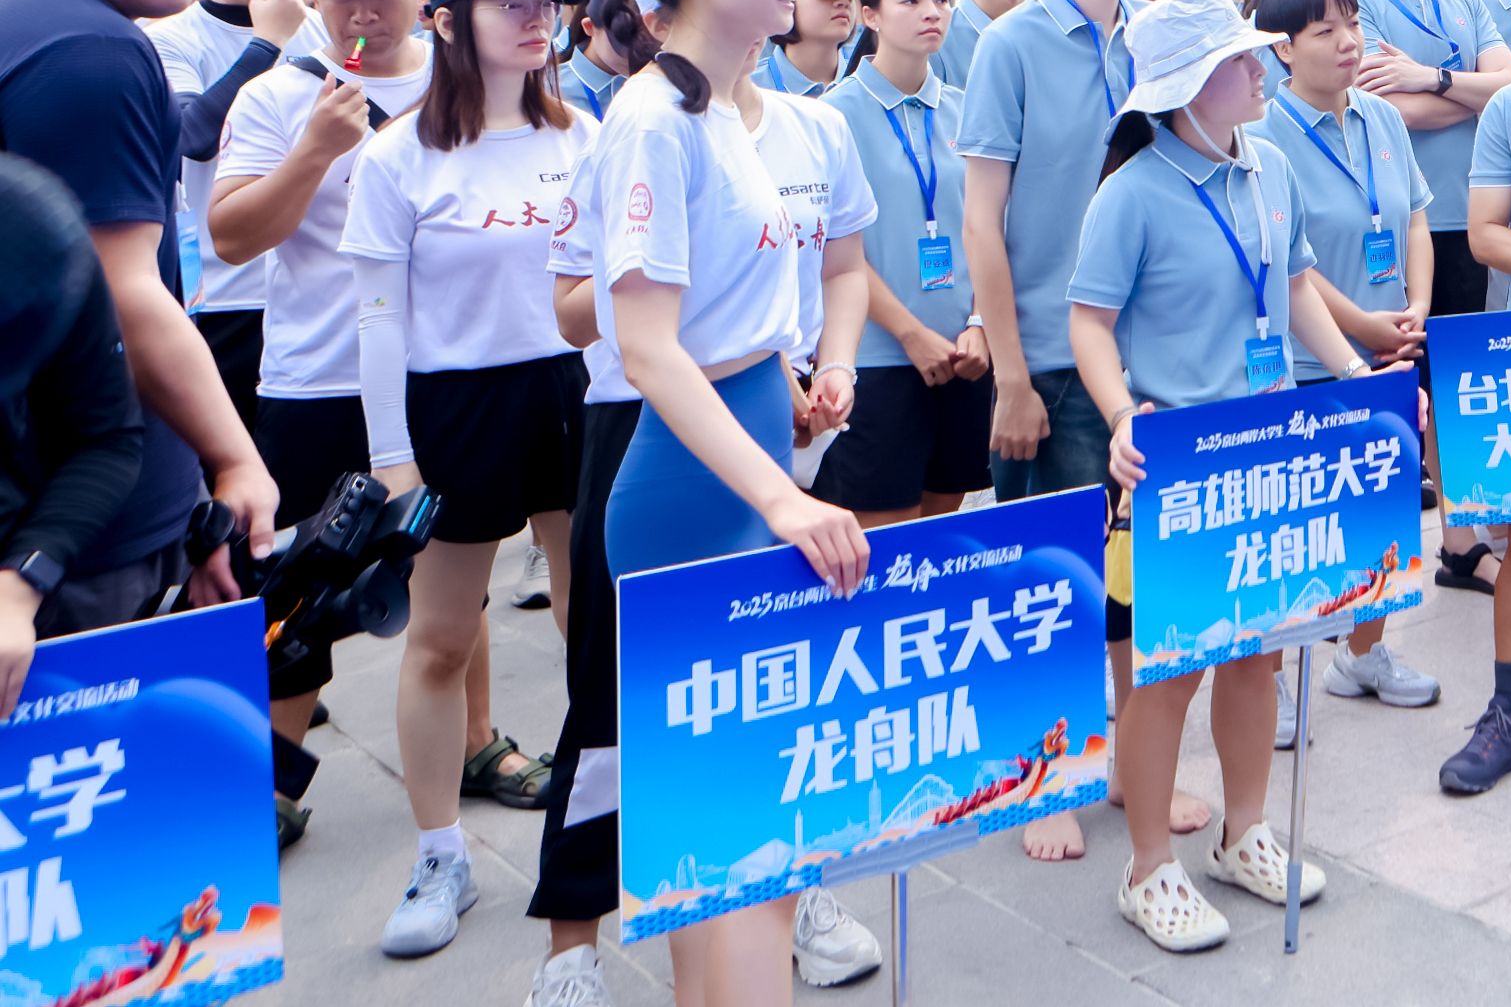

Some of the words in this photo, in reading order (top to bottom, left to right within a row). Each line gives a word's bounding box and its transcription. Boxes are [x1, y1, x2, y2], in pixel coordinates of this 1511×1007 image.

[778, 182, 830, 197] asarte
[1157, 436, 1401, 541] 高雄师范大学
[1225, 511, 1347, 593] 龙舟队
[666, 578, 1073, 737] 中国人民大学
[778, 685, 981, 804] 龙舟队
